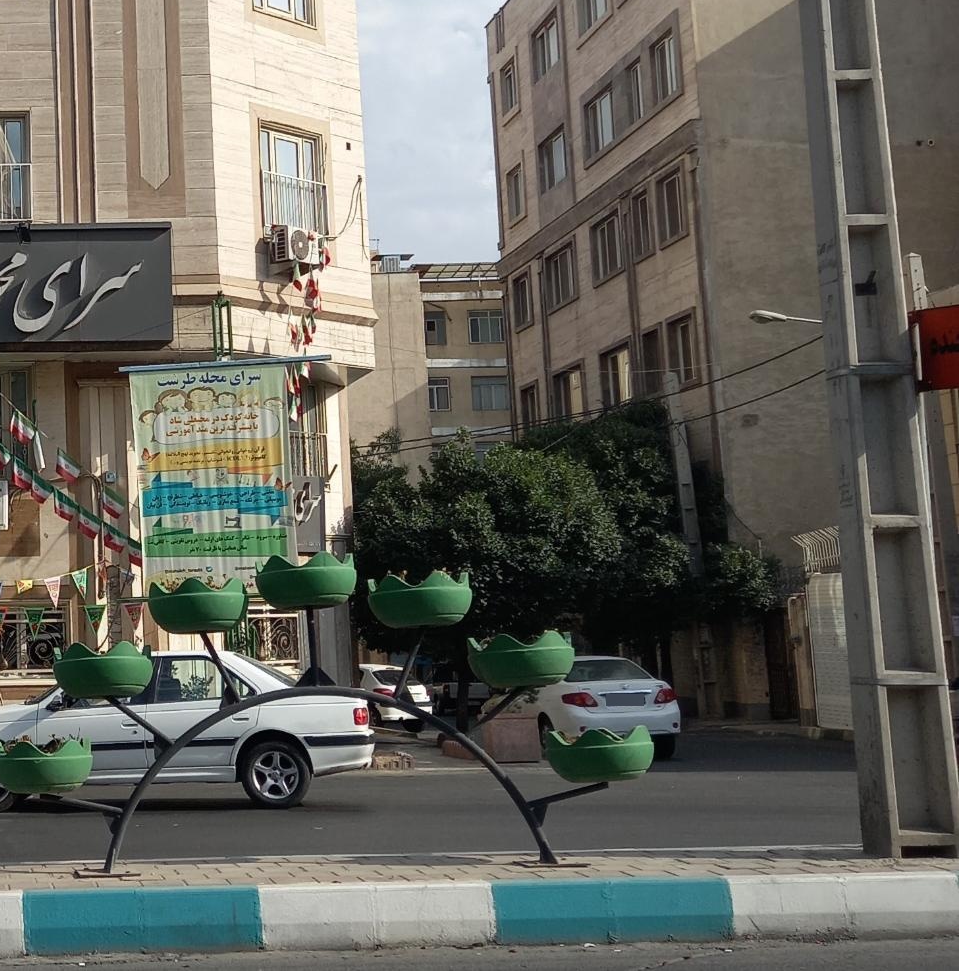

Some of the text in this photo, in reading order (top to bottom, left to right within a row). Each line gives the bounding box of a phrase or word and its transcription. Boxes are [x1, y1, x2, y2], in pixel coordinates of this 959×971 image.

[13, 251, 144, 333] سرای
[157, 370, 261, 389] سرای محله طرشت
[169, 411, 259, 426] خانه کودک در محیطی شاد
